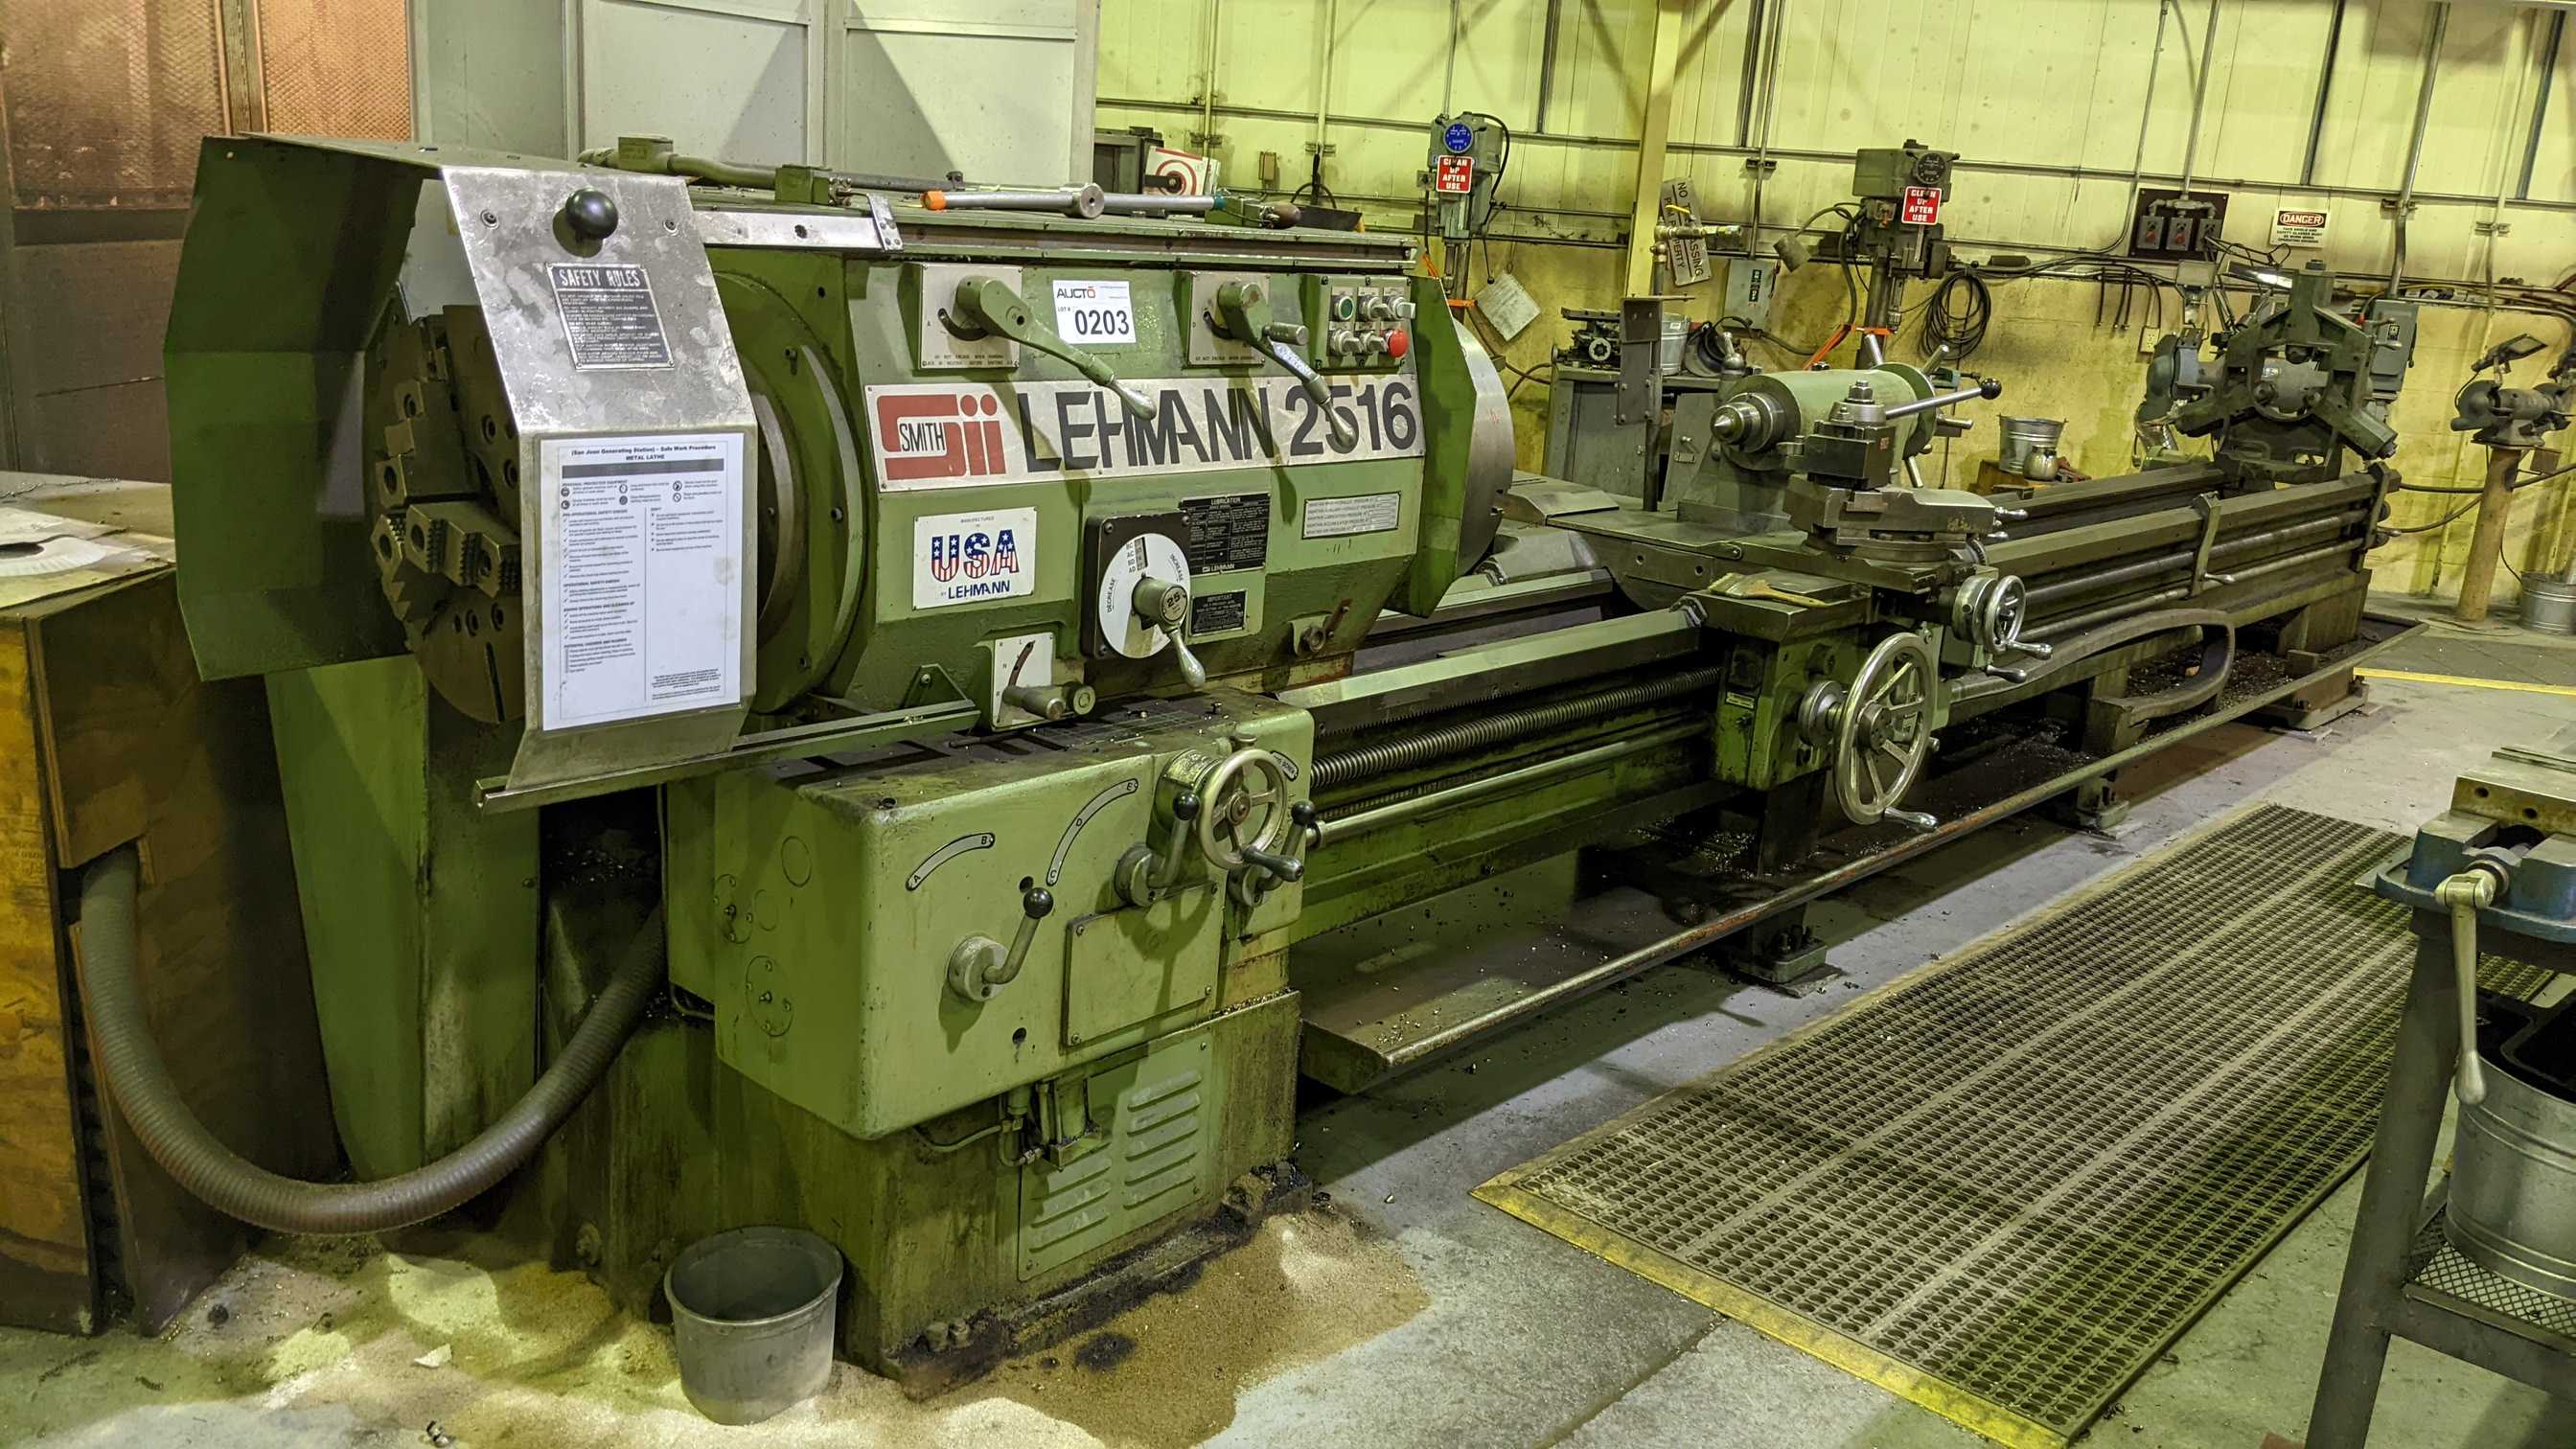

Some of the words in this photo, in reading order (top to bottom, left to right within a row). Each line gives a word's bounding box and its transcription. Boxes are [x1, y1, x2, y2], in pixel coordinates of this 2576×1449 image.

[1442, 173, 1466, 182] AFTER
[1677, 182, 1689, 198] NO
[2283, 214, 2321, 224] DANGER
[559, 268, 601, 287] SAFETY
[606, 269, 640, 287] RULES
[1074, 310, 1130, 335] 0203
[1017, 387, 1275, 472] LEHMANN
[1285, 381, 1416, 456] 2516
[899, 422, 946, 452] SMITH
[931, 529, 1020, 583] USA
[948, 580, 1010, 599] LEHMANN
[1106, 577, 1116, 613] DECREASE
[1167, 592, 1181, 608] 25
[1127, 782, 1133, 792] E
[981, 836, 987, 845] B
[913, 874, 921, 884] A
